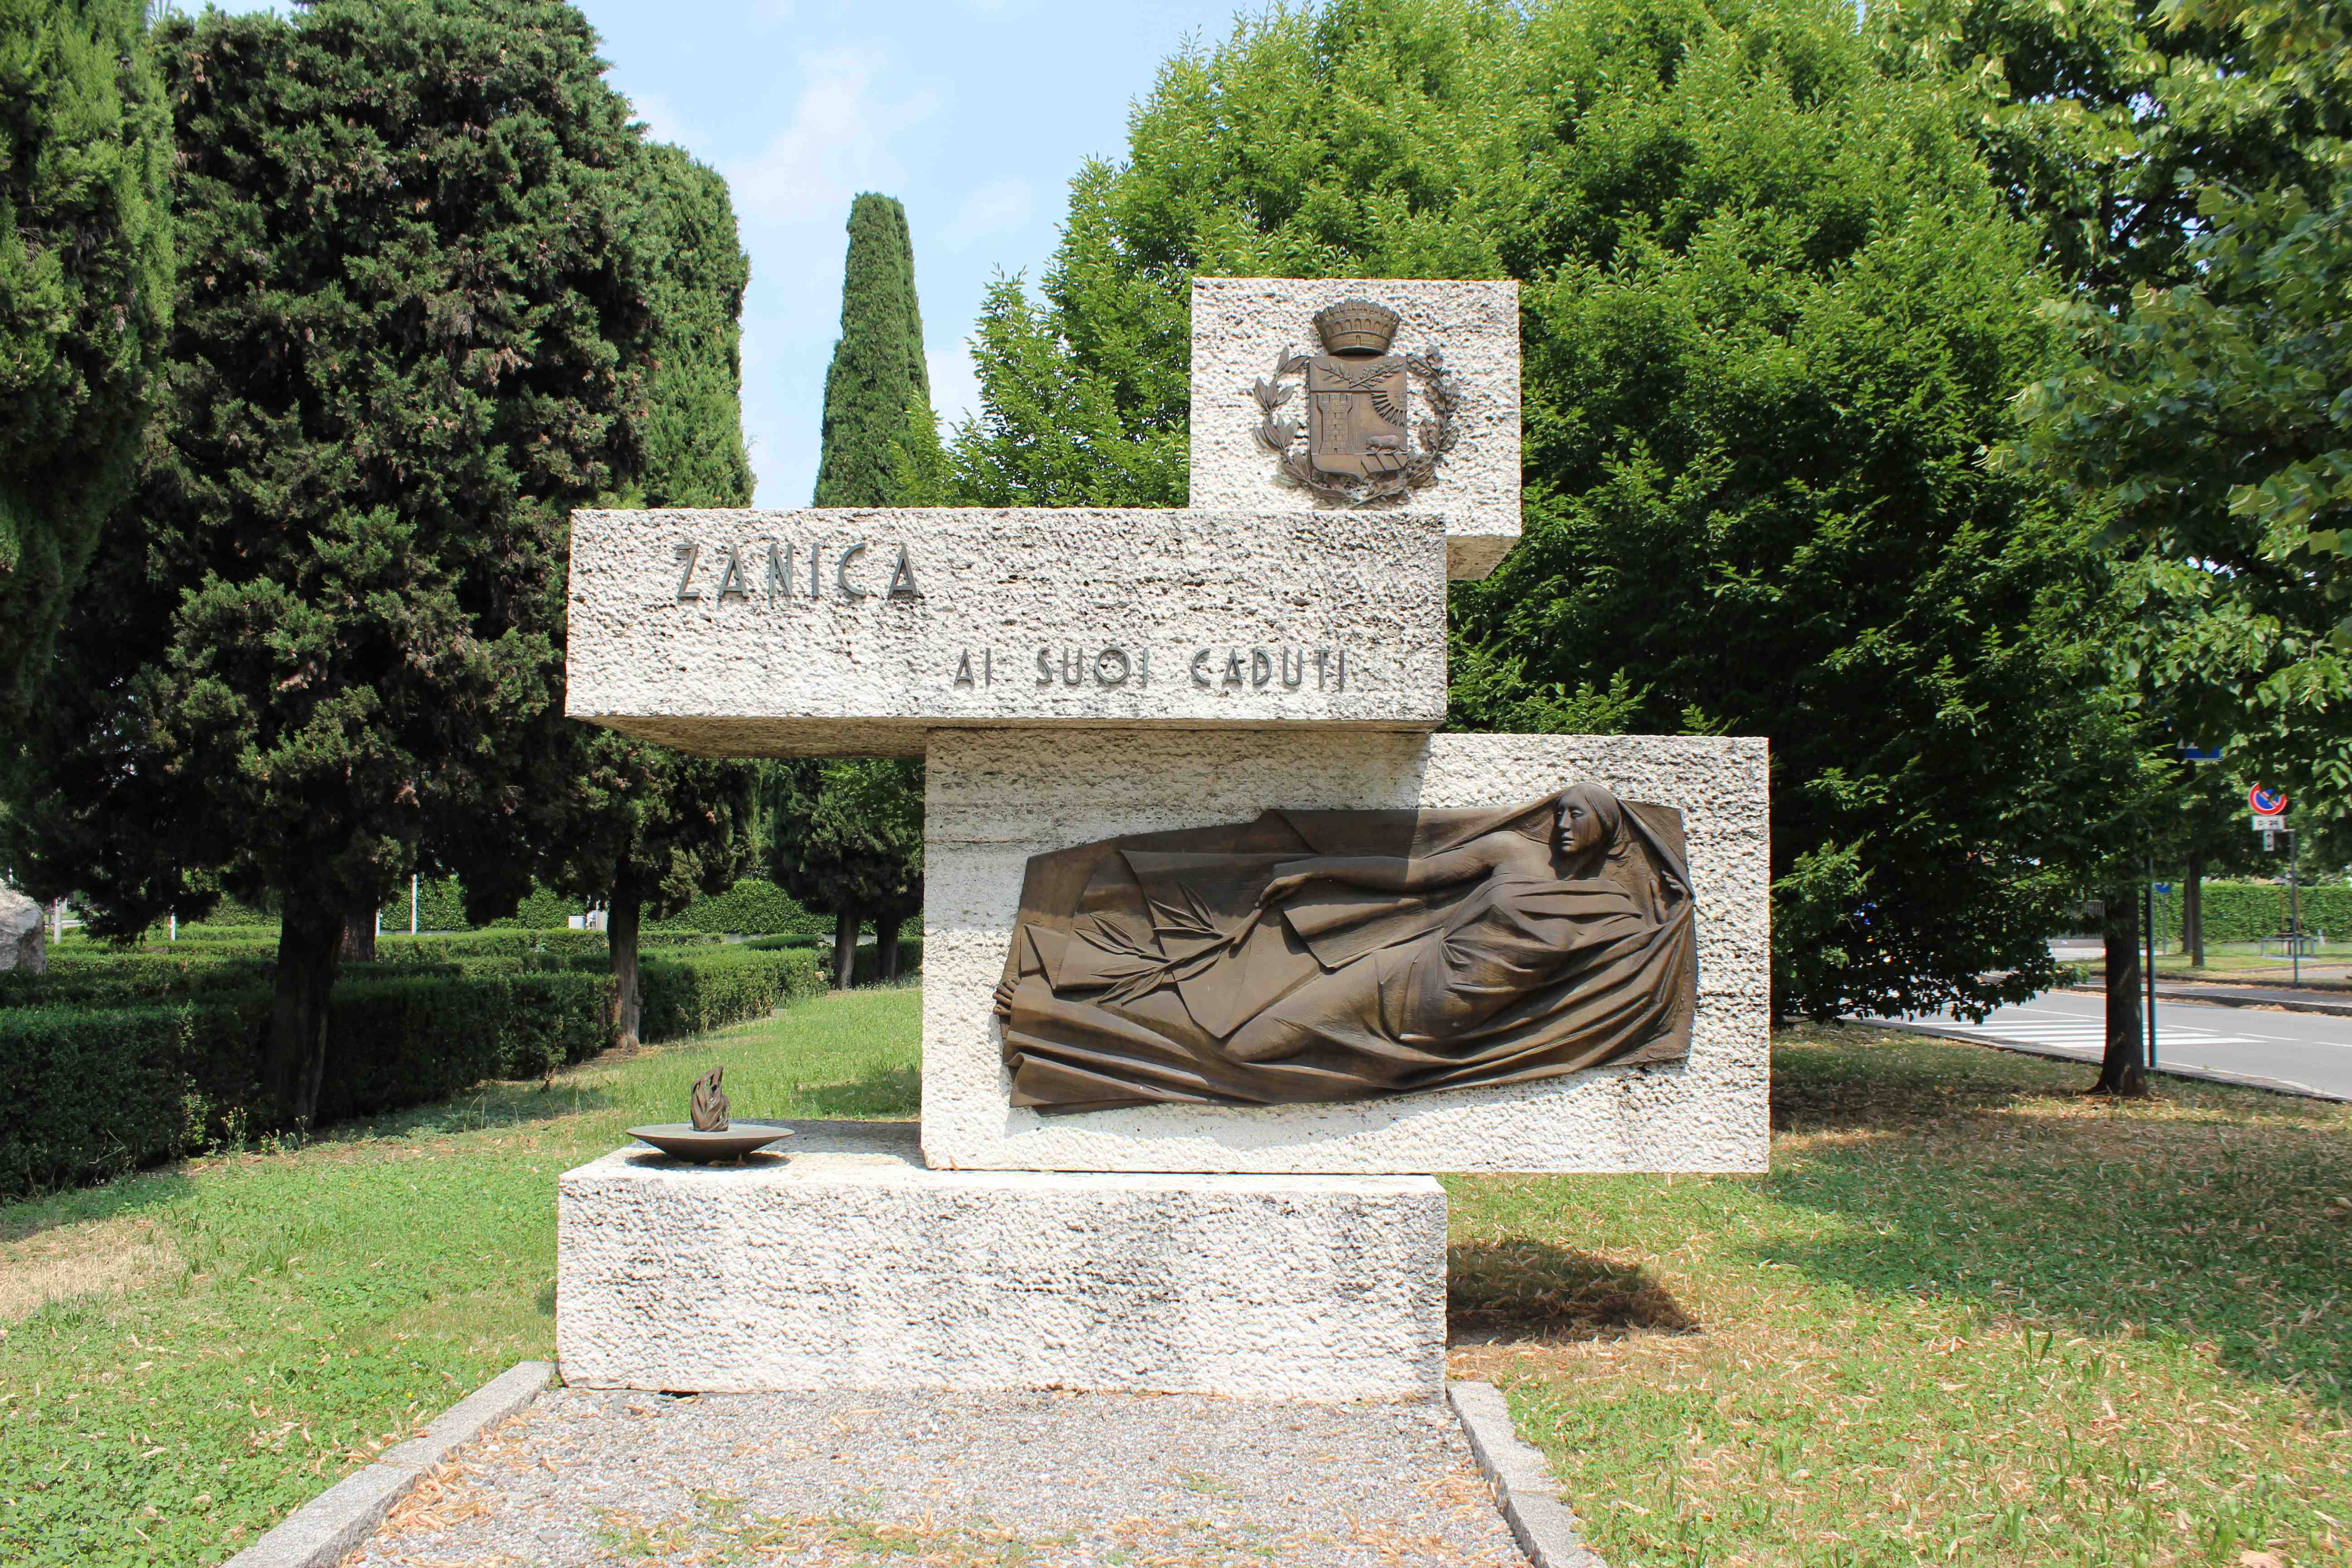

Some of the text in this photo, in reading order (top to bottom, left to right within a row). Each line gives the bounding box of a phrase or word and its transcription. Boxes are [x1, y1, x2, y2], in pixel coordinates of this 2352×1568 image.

[676, 543, 921, 599] ZANICA
[954, 647, 1345, 688] AI SUOI CADUTI
